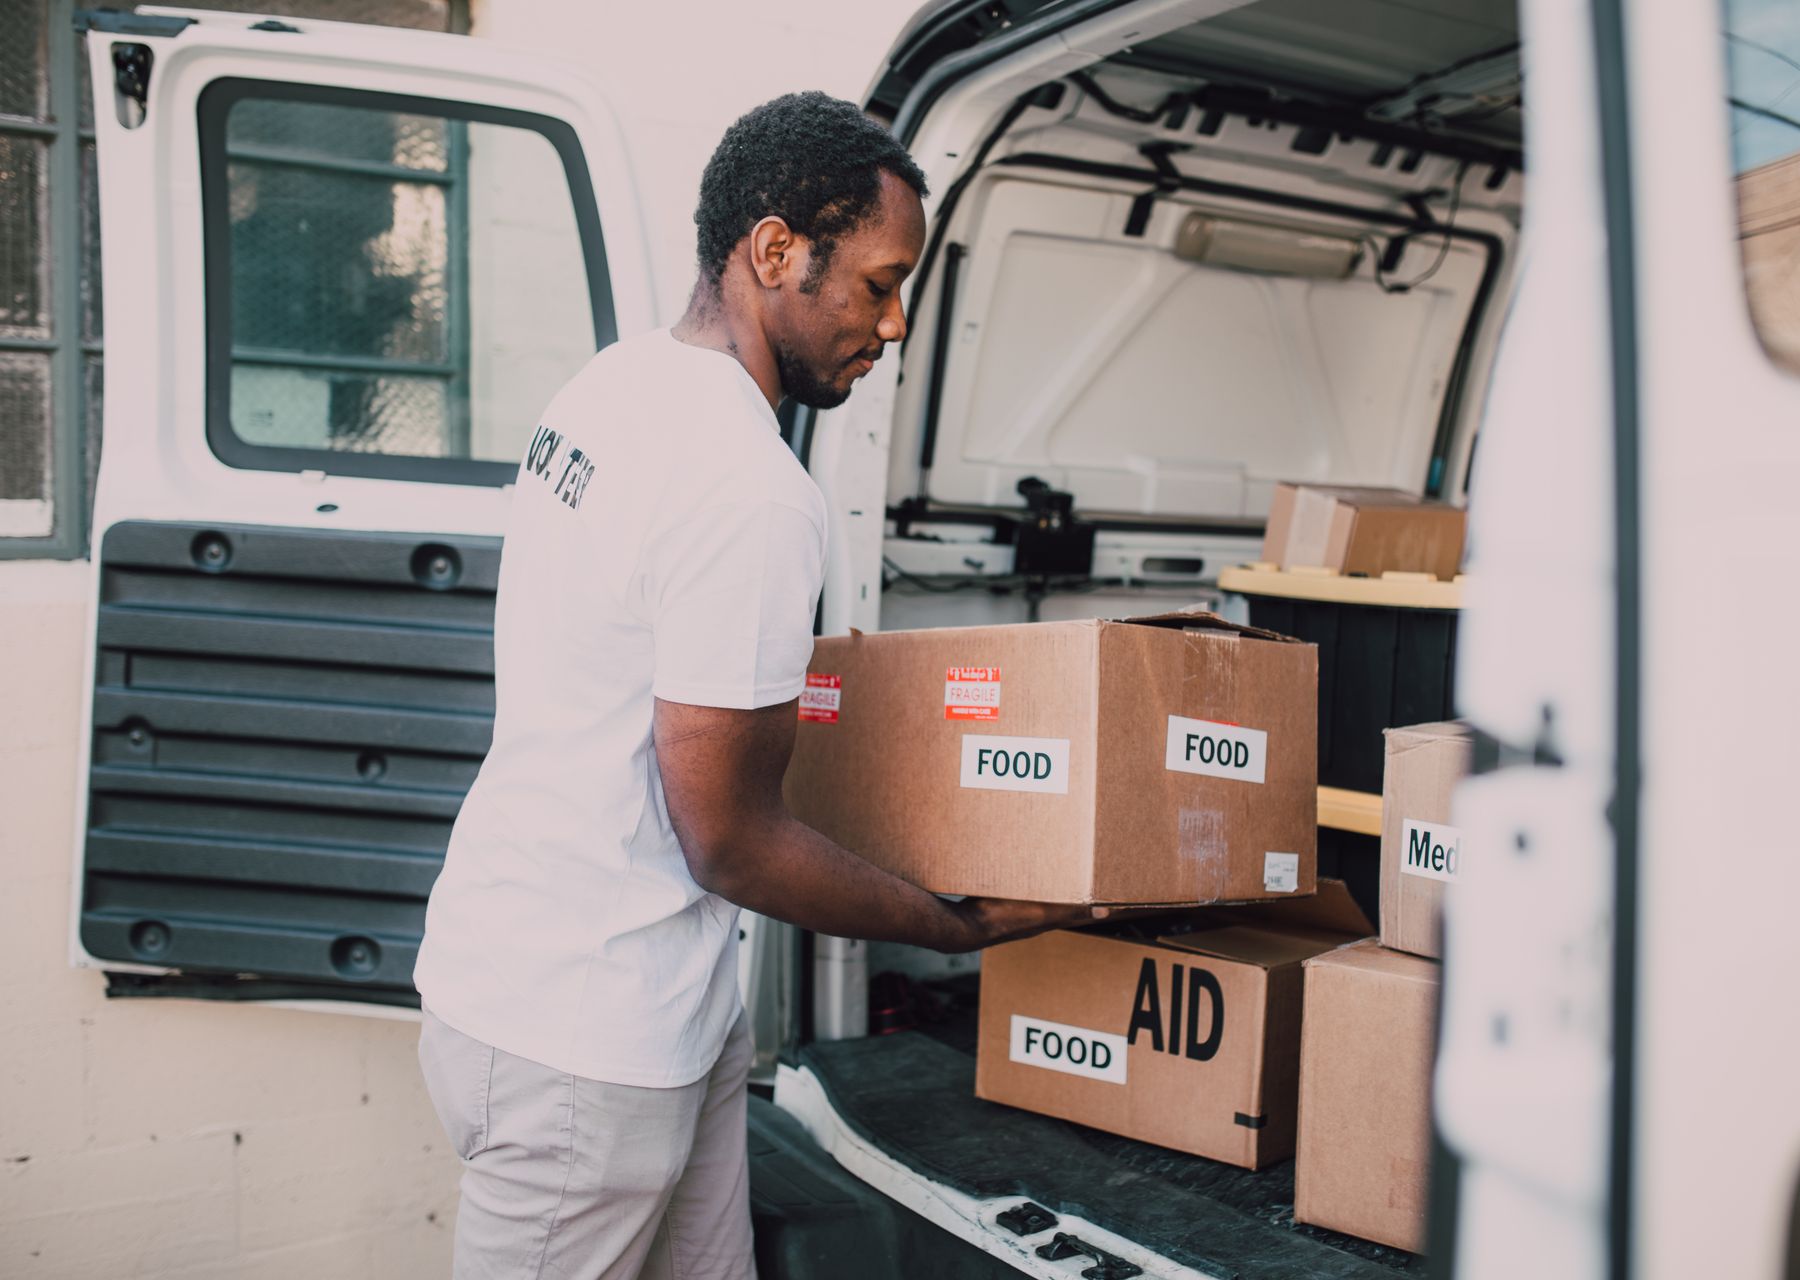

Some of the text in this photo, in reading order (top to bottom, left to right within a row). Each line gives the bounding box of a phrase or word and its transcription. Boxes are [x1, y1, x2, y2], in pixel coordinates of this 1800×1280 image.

[951, 687, 995, 702] FRAGILE
[977, 748, 1052, 780] FOOD
[1185, 733, 1249, 768] FOOD
[1127, 957, 1224, 1062] AID
[1025, 1027, 1112, 1069] FOOD
